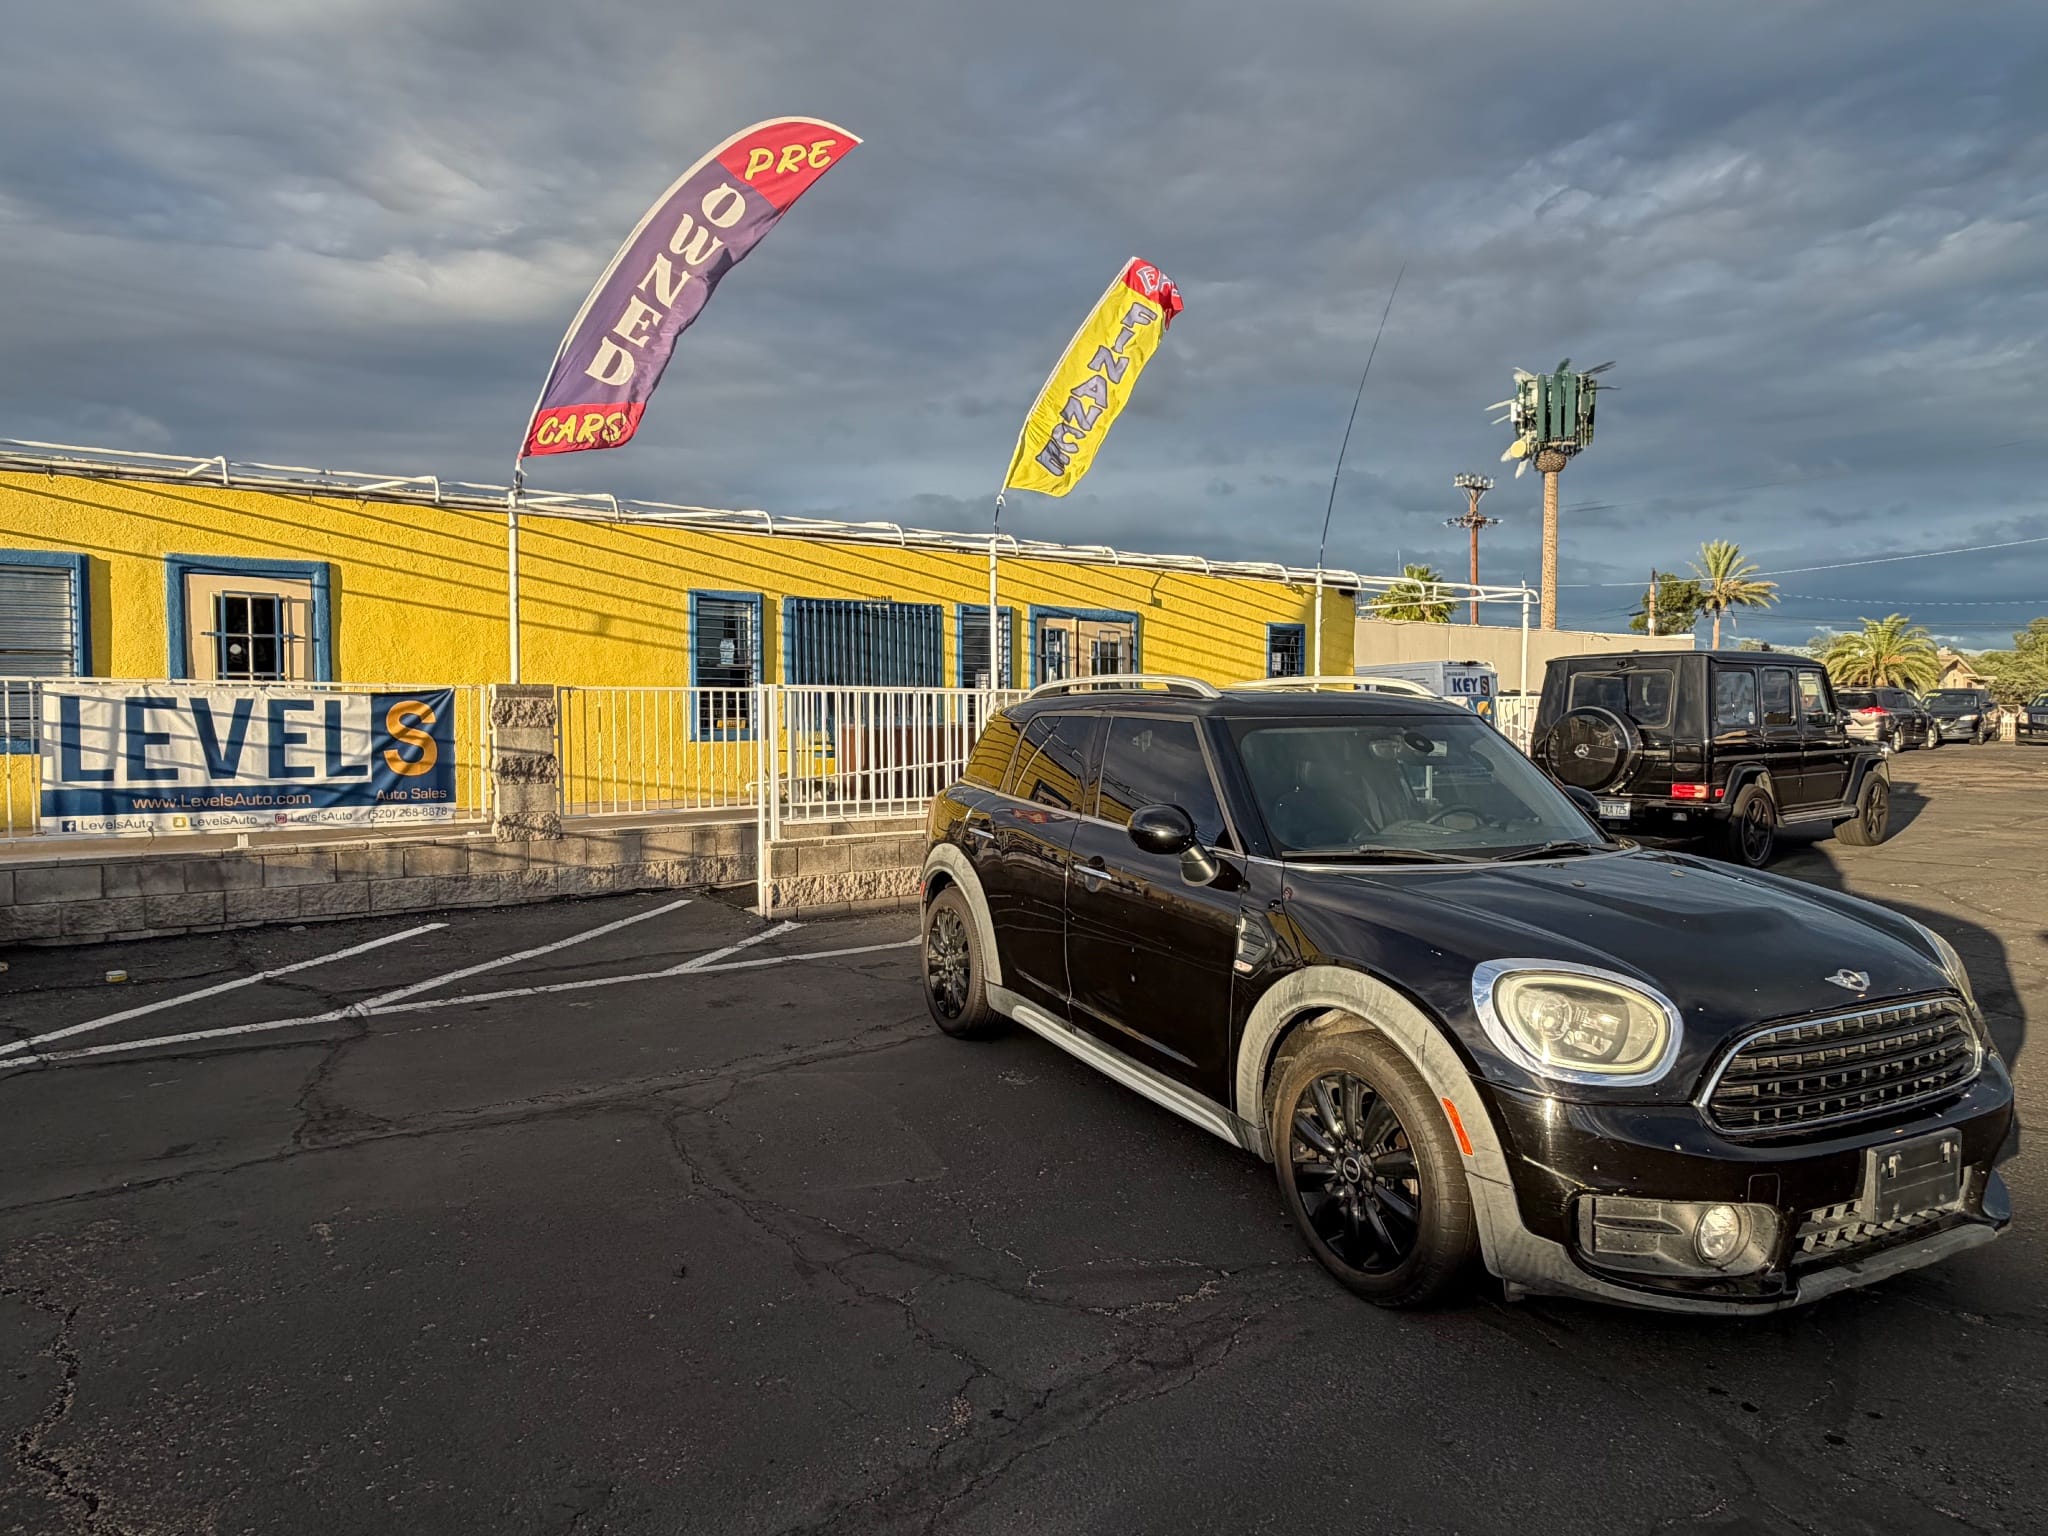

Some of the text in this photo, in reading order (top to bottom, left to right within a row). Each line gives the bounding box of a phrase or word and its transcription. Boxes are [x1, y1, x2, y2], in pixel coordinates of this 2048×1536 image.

[744, 139, 837, 181] PRE
[584, 182, 746, 386] OWNED
[1035, 301, 1158, 477] FINANCE
[536, 412, 628, 446] CARS
[60, 694, 438, 782] LEVELS
[132, 791, 312, 809] www.LevelsAuto.com
[376, 787, 447, 801] Auto Sales
[81, 818, 154, 832] LevelsAuto
[190, 816, 258, 828] LevelsAuto
[368, 809, 396, 820] (520)
